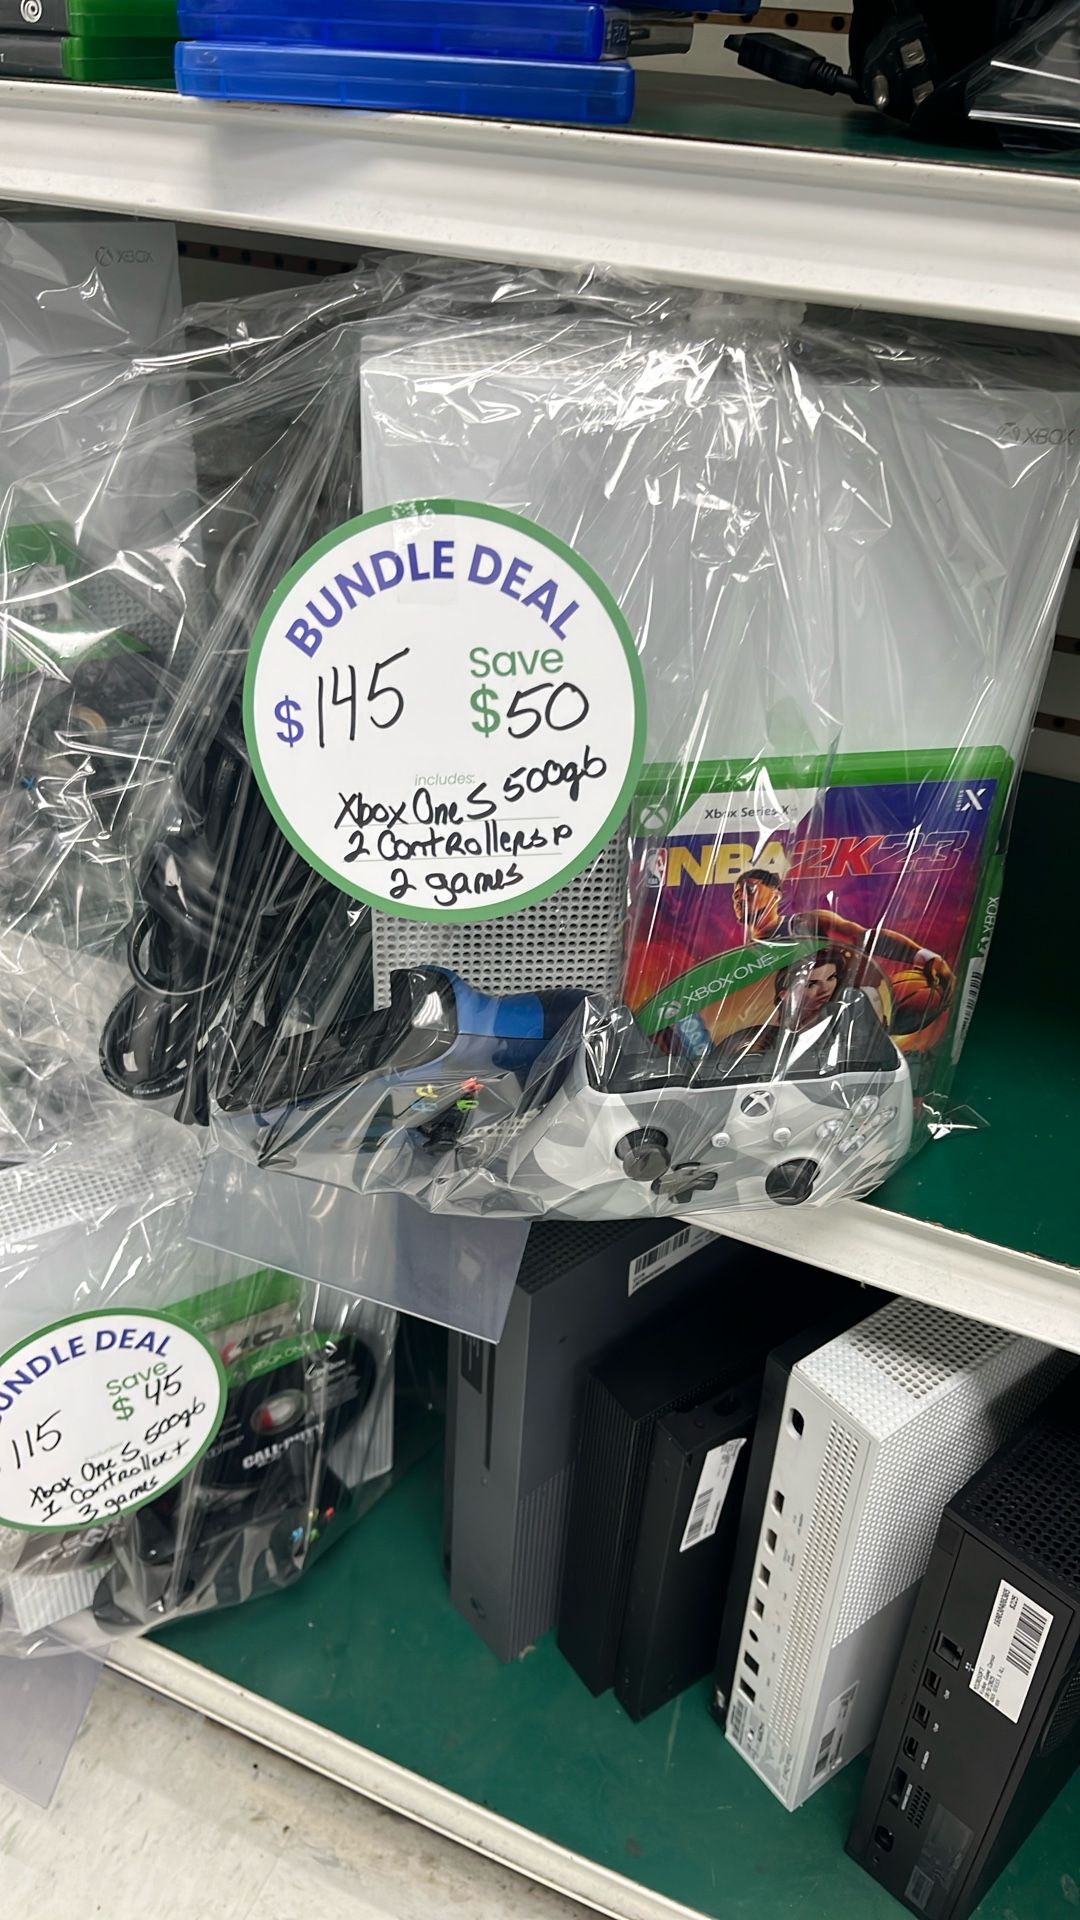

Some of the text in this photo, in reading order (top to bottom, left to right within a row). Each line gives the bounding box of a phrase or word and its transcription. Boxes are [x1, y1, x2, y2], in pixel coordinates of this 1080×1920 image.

[285, 540, 580, 658] BUNDLE DEAL
[468, 646, 564, 678] Save
[414, 773, 476, 787] includes:
[466, 782, 497, 820] S
[344, 830, 371, 862] 2
[666, 840, 791, 887] NBA
[390, 862, 524, 907] 2 games
[982, 896, 1000, 934] XBOX
[683, 952, 780, 1006] XBOX ONE
[0, 1335, 87, 1425] UNDLE
[95, 1328, 171, 1358] DEAL
[121, 1440, 141, 1463] S
[78, 1503, 99, 1525] 3
